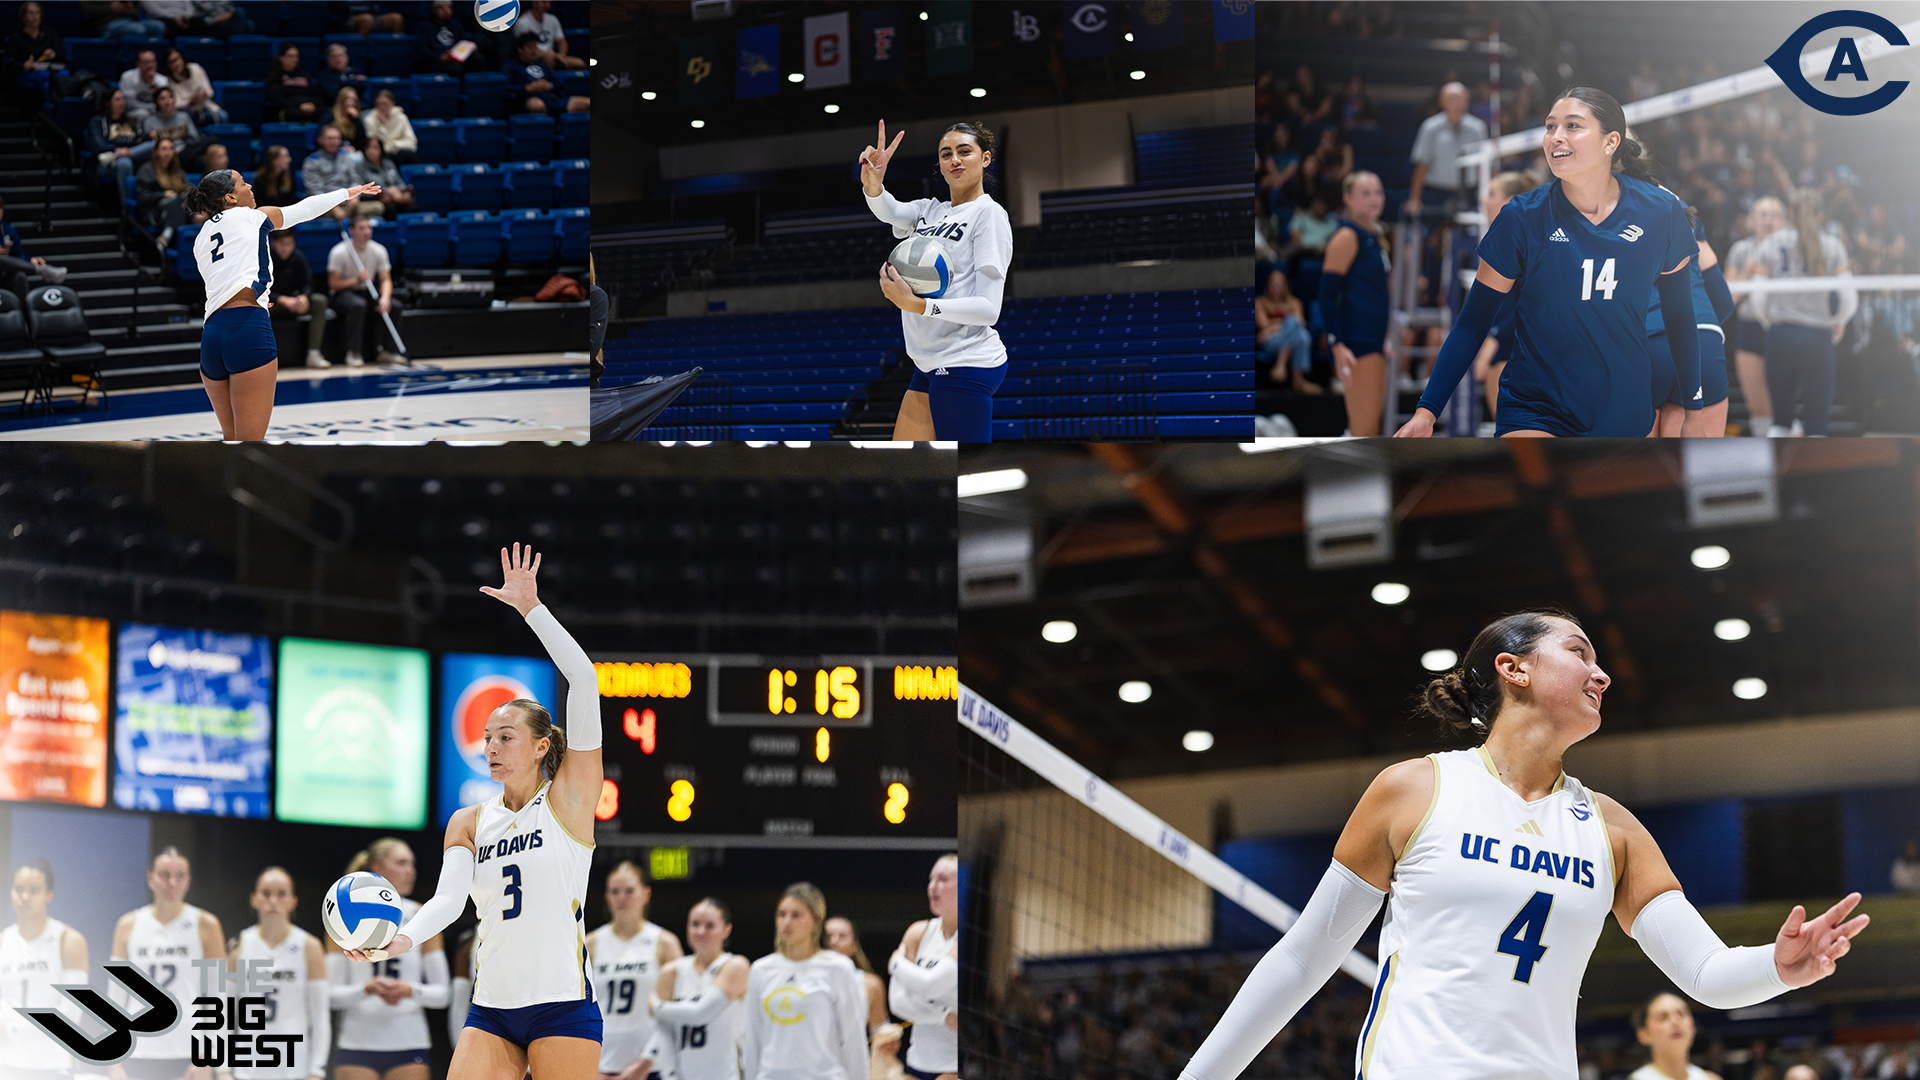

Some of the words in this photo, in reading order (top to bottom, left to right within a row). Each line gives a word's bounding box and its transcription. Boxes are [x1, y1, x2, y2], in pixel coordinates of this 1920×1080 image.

[210, 231, 225, 264] 2
[1581, 258, 1619, 301] 14
[768, 666, 860, 720] 1:15
[623, 708, 657, 755] 4
[816, 726, 831, 763] 1
[496, 829, 543, 858] DAVIS
[1460, 832, 1501, 864] UC
[1510, 843, 1596, 889] DAVIS
[502, 863, 523, 922] 3
[1494, 888, 1557, 986] 4
[607, 979, 637, 1015] 19
